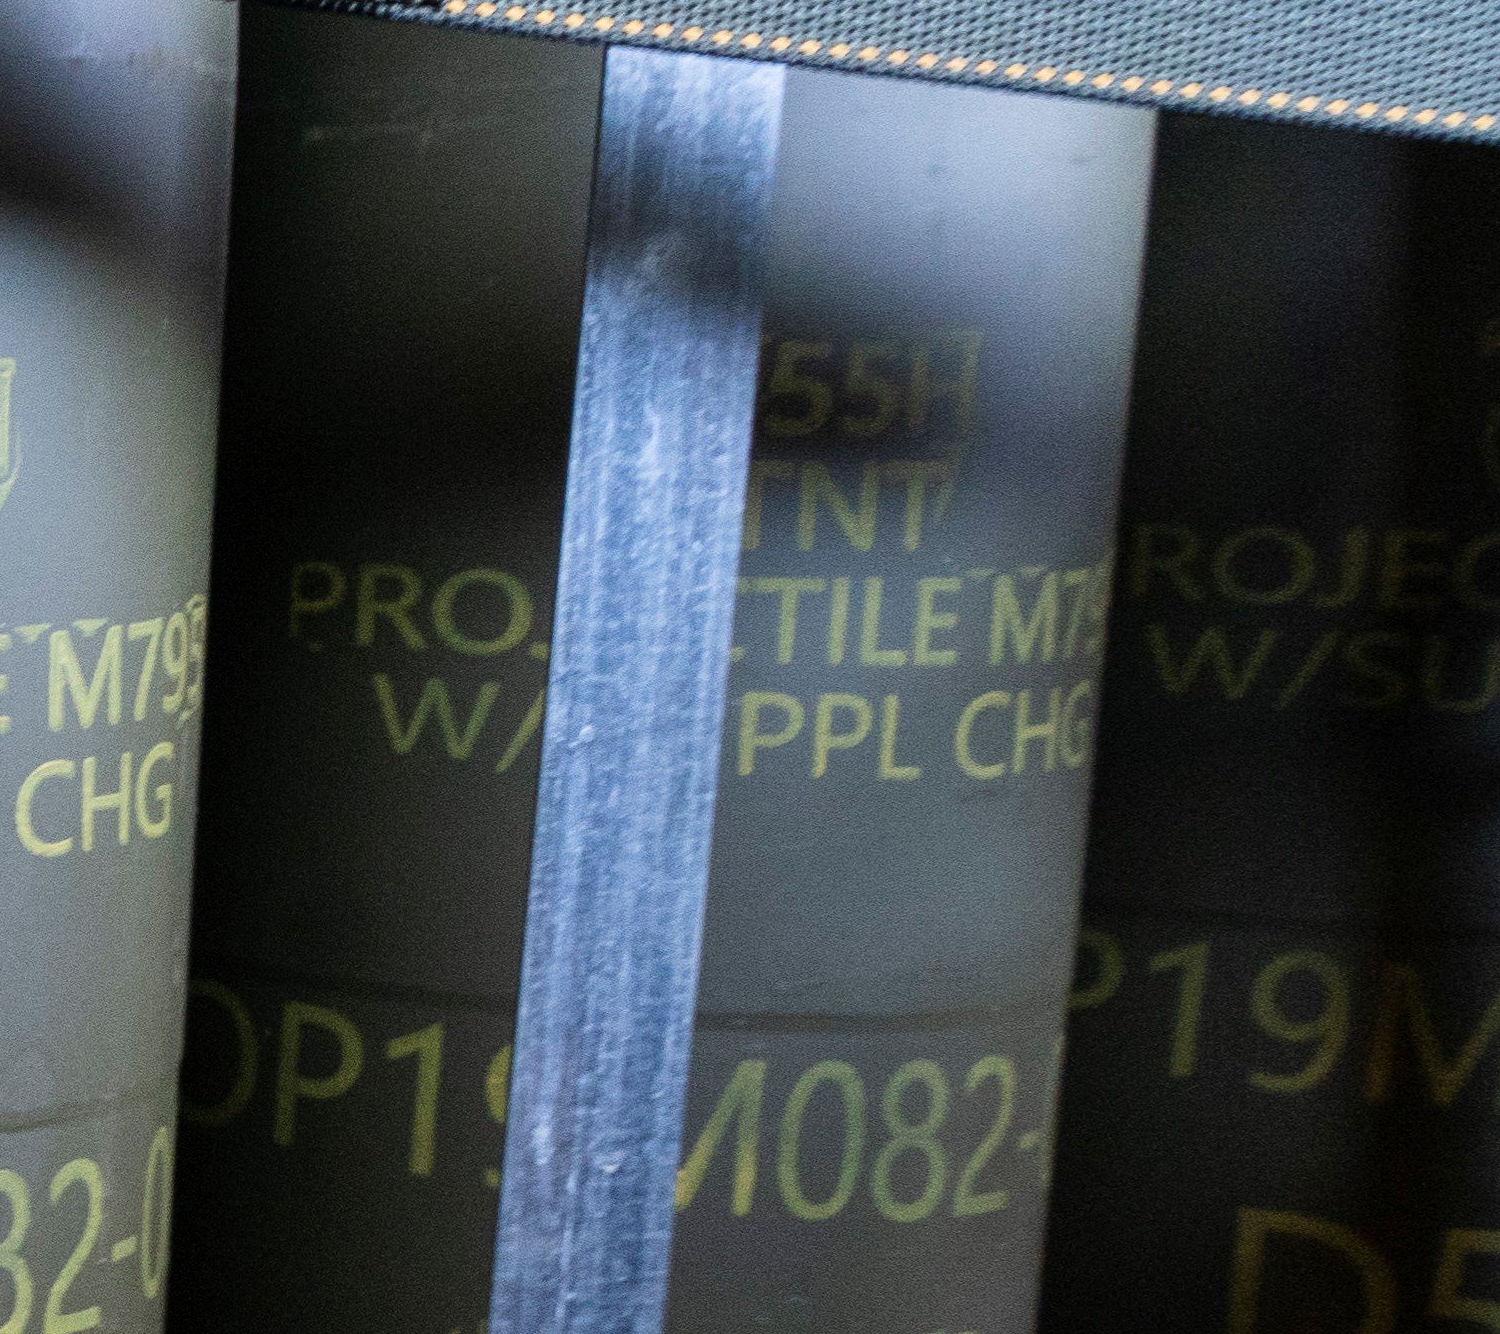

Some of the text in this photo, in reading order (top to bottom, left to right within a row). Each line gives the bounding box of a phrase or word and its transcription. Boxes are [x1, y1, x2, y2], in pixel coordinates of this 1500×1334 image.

[762, 332, 979, 442] 55H
[954, 679, 1093, 780] CHG
[13, 740, 175, 858] CHG
